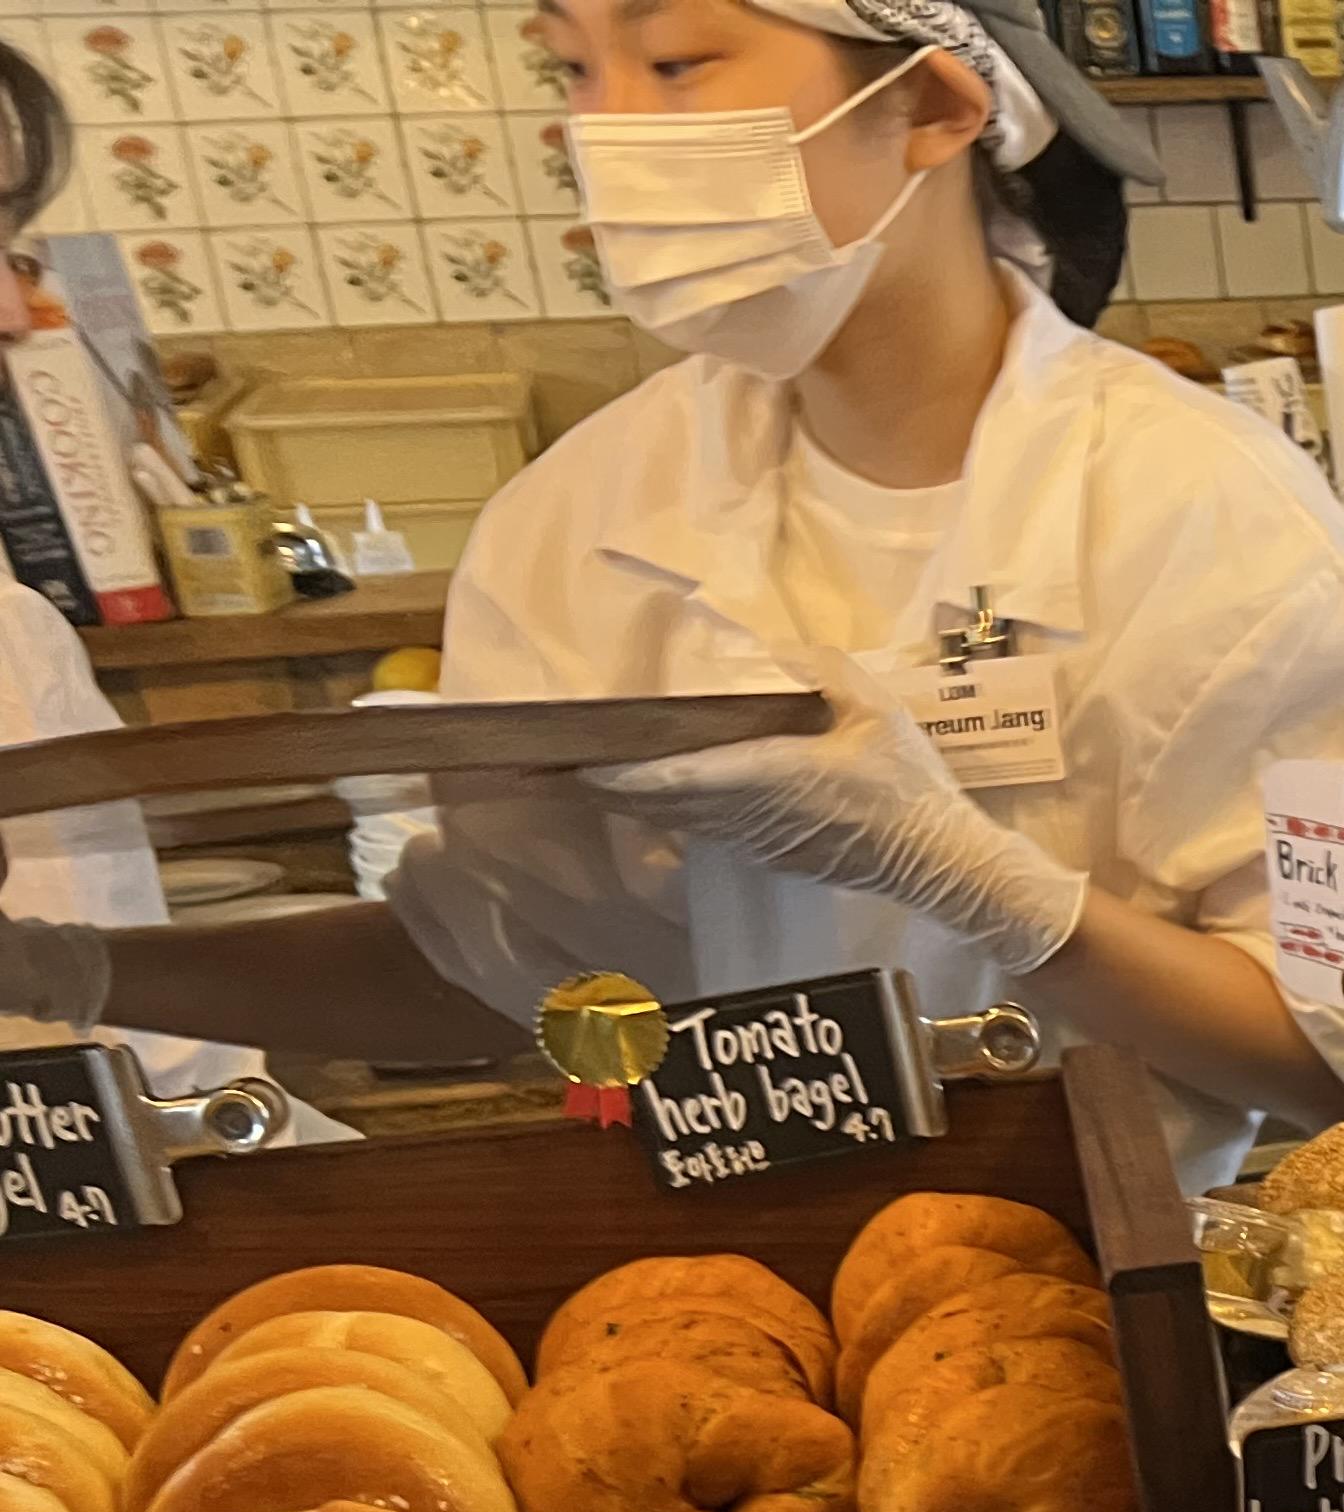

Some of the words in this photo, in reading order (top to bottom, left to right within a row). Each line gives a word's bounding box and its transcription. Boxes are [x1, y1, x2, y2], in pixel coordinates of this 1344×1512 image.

[1276, 839, 1338, 892] Brick
[668, 993, 842, 1071] Tomato
[641, 1071, 747, 1142] herb
[755, 1052, 869, 1131] bagel
[840, 1106, 895, 1143] 4.7
[57, 1185, 119, 1229] 4.7
